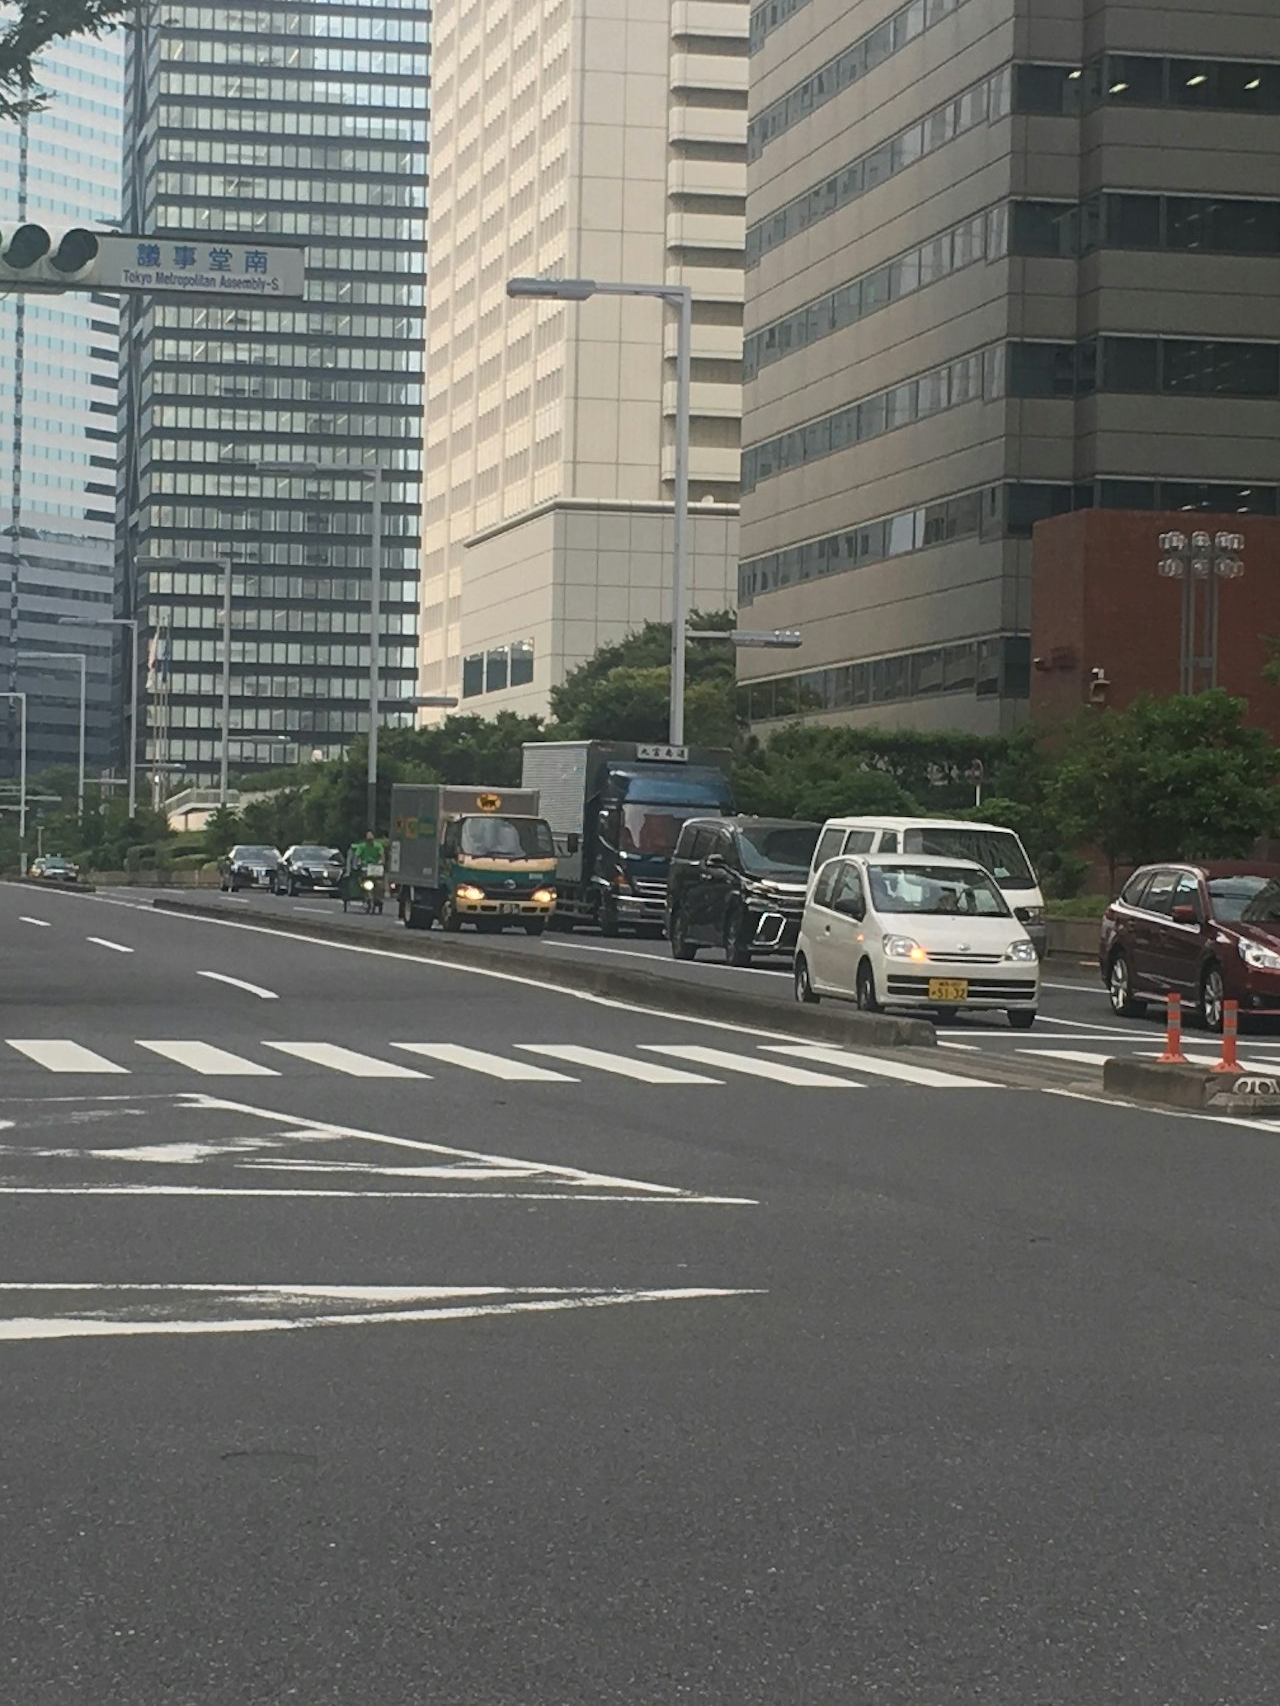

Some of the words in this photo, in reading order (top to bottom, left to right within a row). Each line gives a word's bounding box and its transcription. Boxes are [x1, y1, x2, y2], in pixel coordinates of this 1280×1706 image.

[136, 243, 269, 275] 議事堂南
[122, 269, 153, 285] Tokyo
[156, 272, 216, 289] Metropolitan
[220, 275, 280, 293] Assembly-S.
